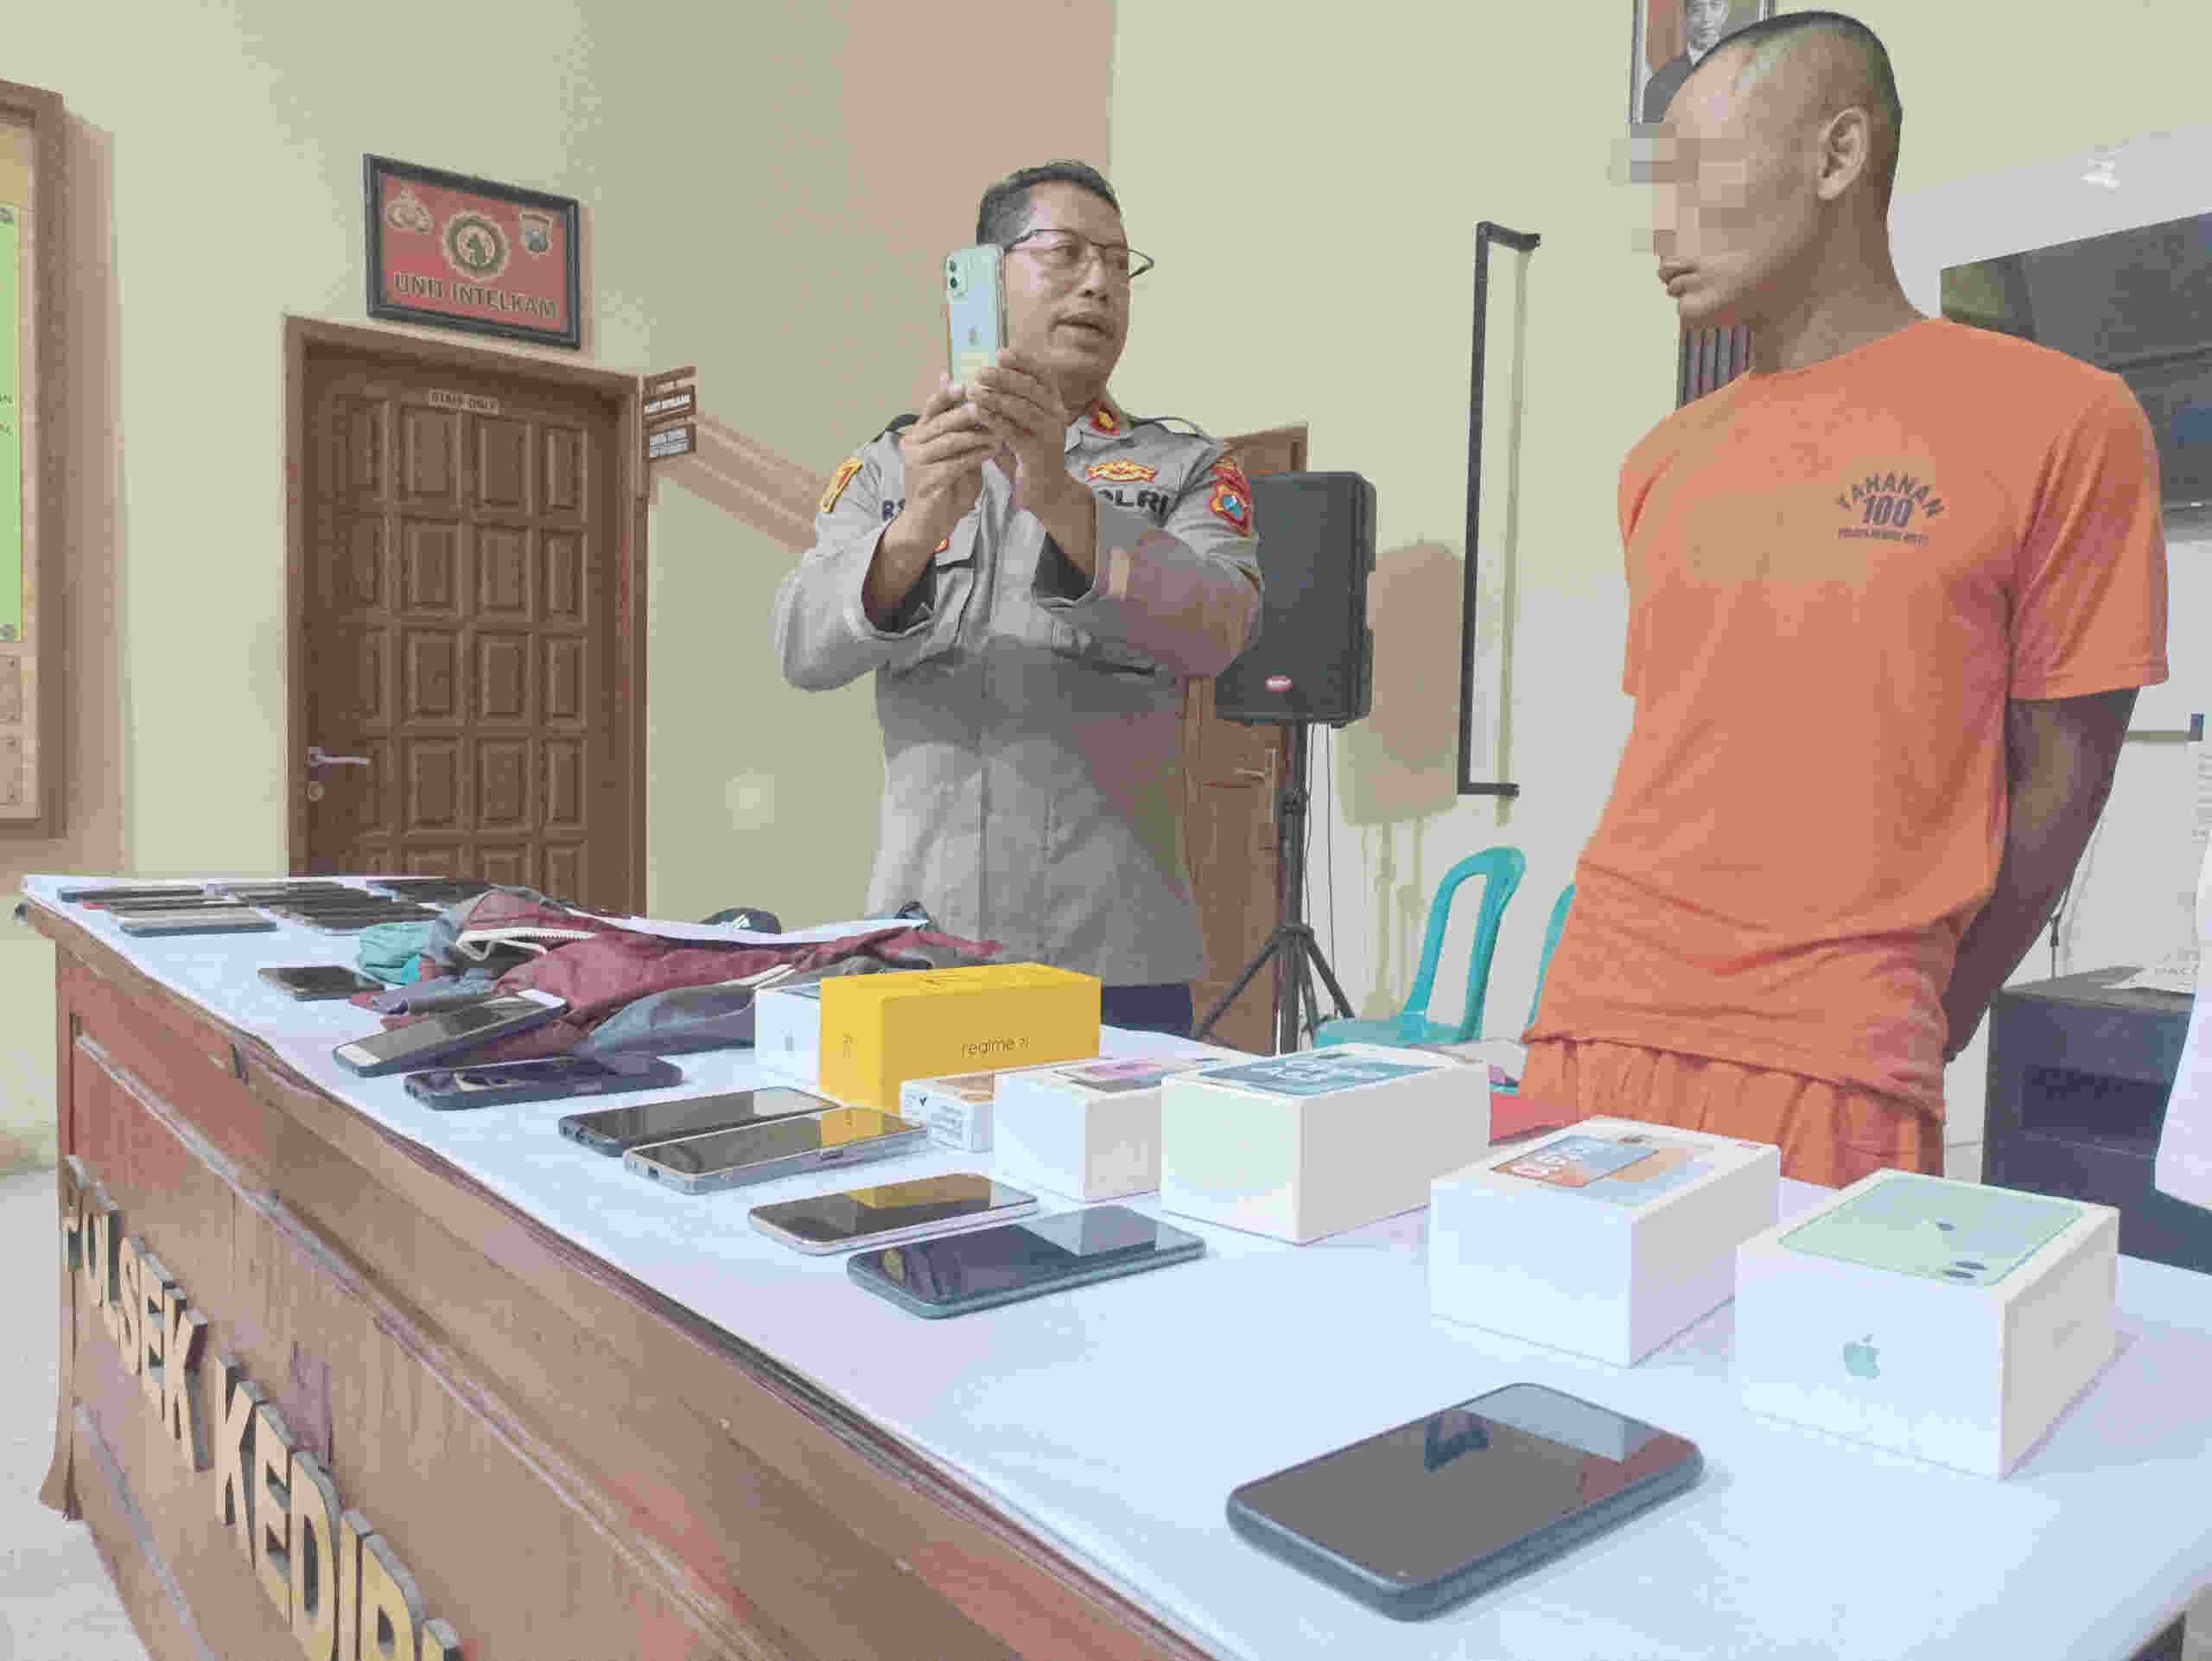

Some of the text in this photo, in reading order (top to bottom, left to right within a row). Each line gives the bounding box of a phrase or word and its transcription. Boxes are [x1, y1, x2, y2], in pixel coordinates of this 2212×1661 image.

[393, 271, 557, 319] UNIT INTELKAM
[1862, 494, 1914, 527] 100
